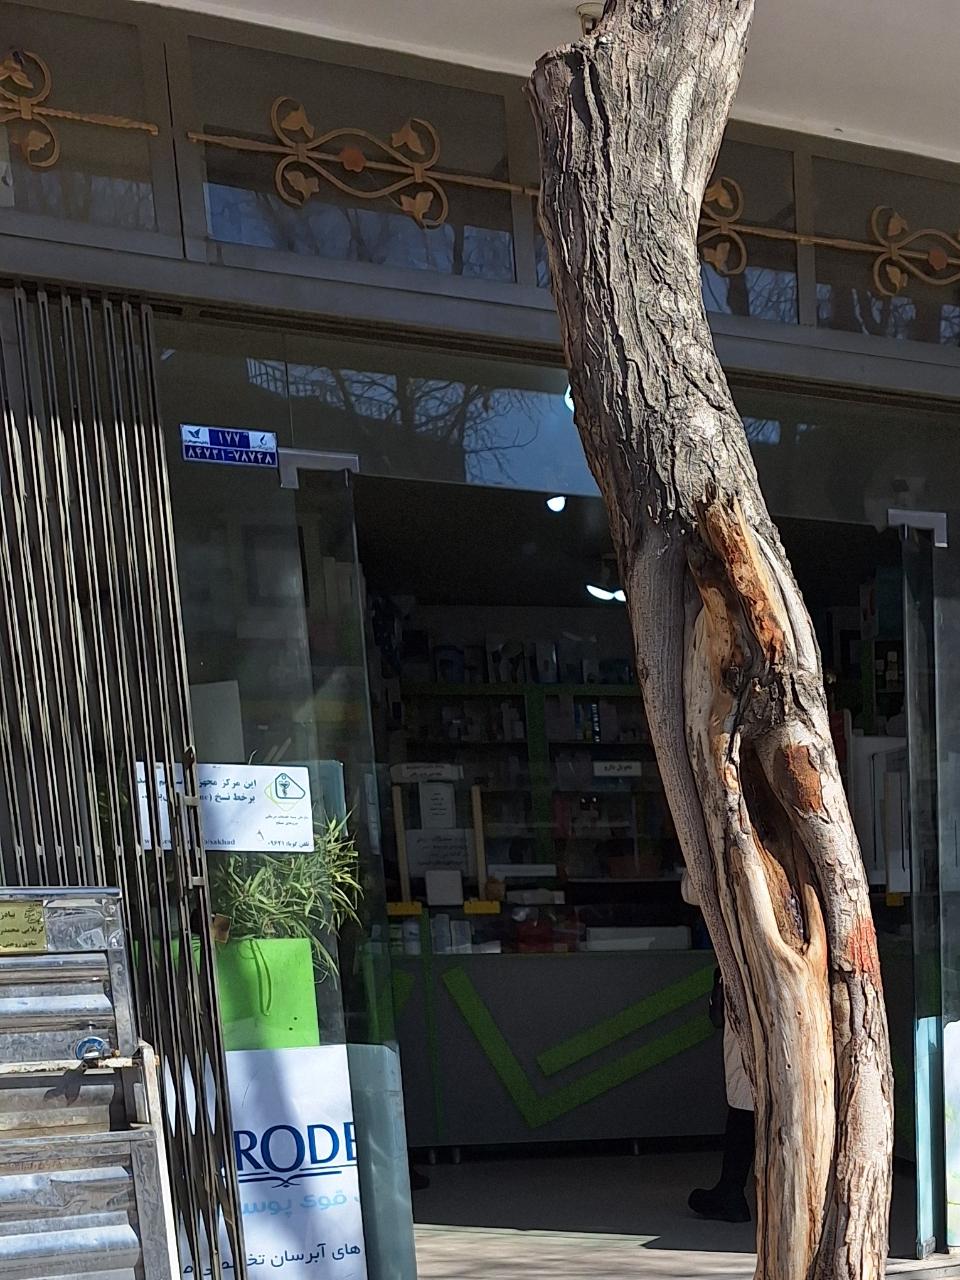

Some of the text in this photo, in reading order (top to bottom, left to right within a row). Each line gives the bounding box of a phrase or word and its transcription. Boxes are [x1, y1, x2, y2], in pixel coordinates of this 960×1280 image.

[218, 431, 240, 446] ۱۷۷
[299, 1190, 348, 1211] قوی
[270, 1243, 327, 1268] آبرسان
[331, 1243, 361, 1260] های
